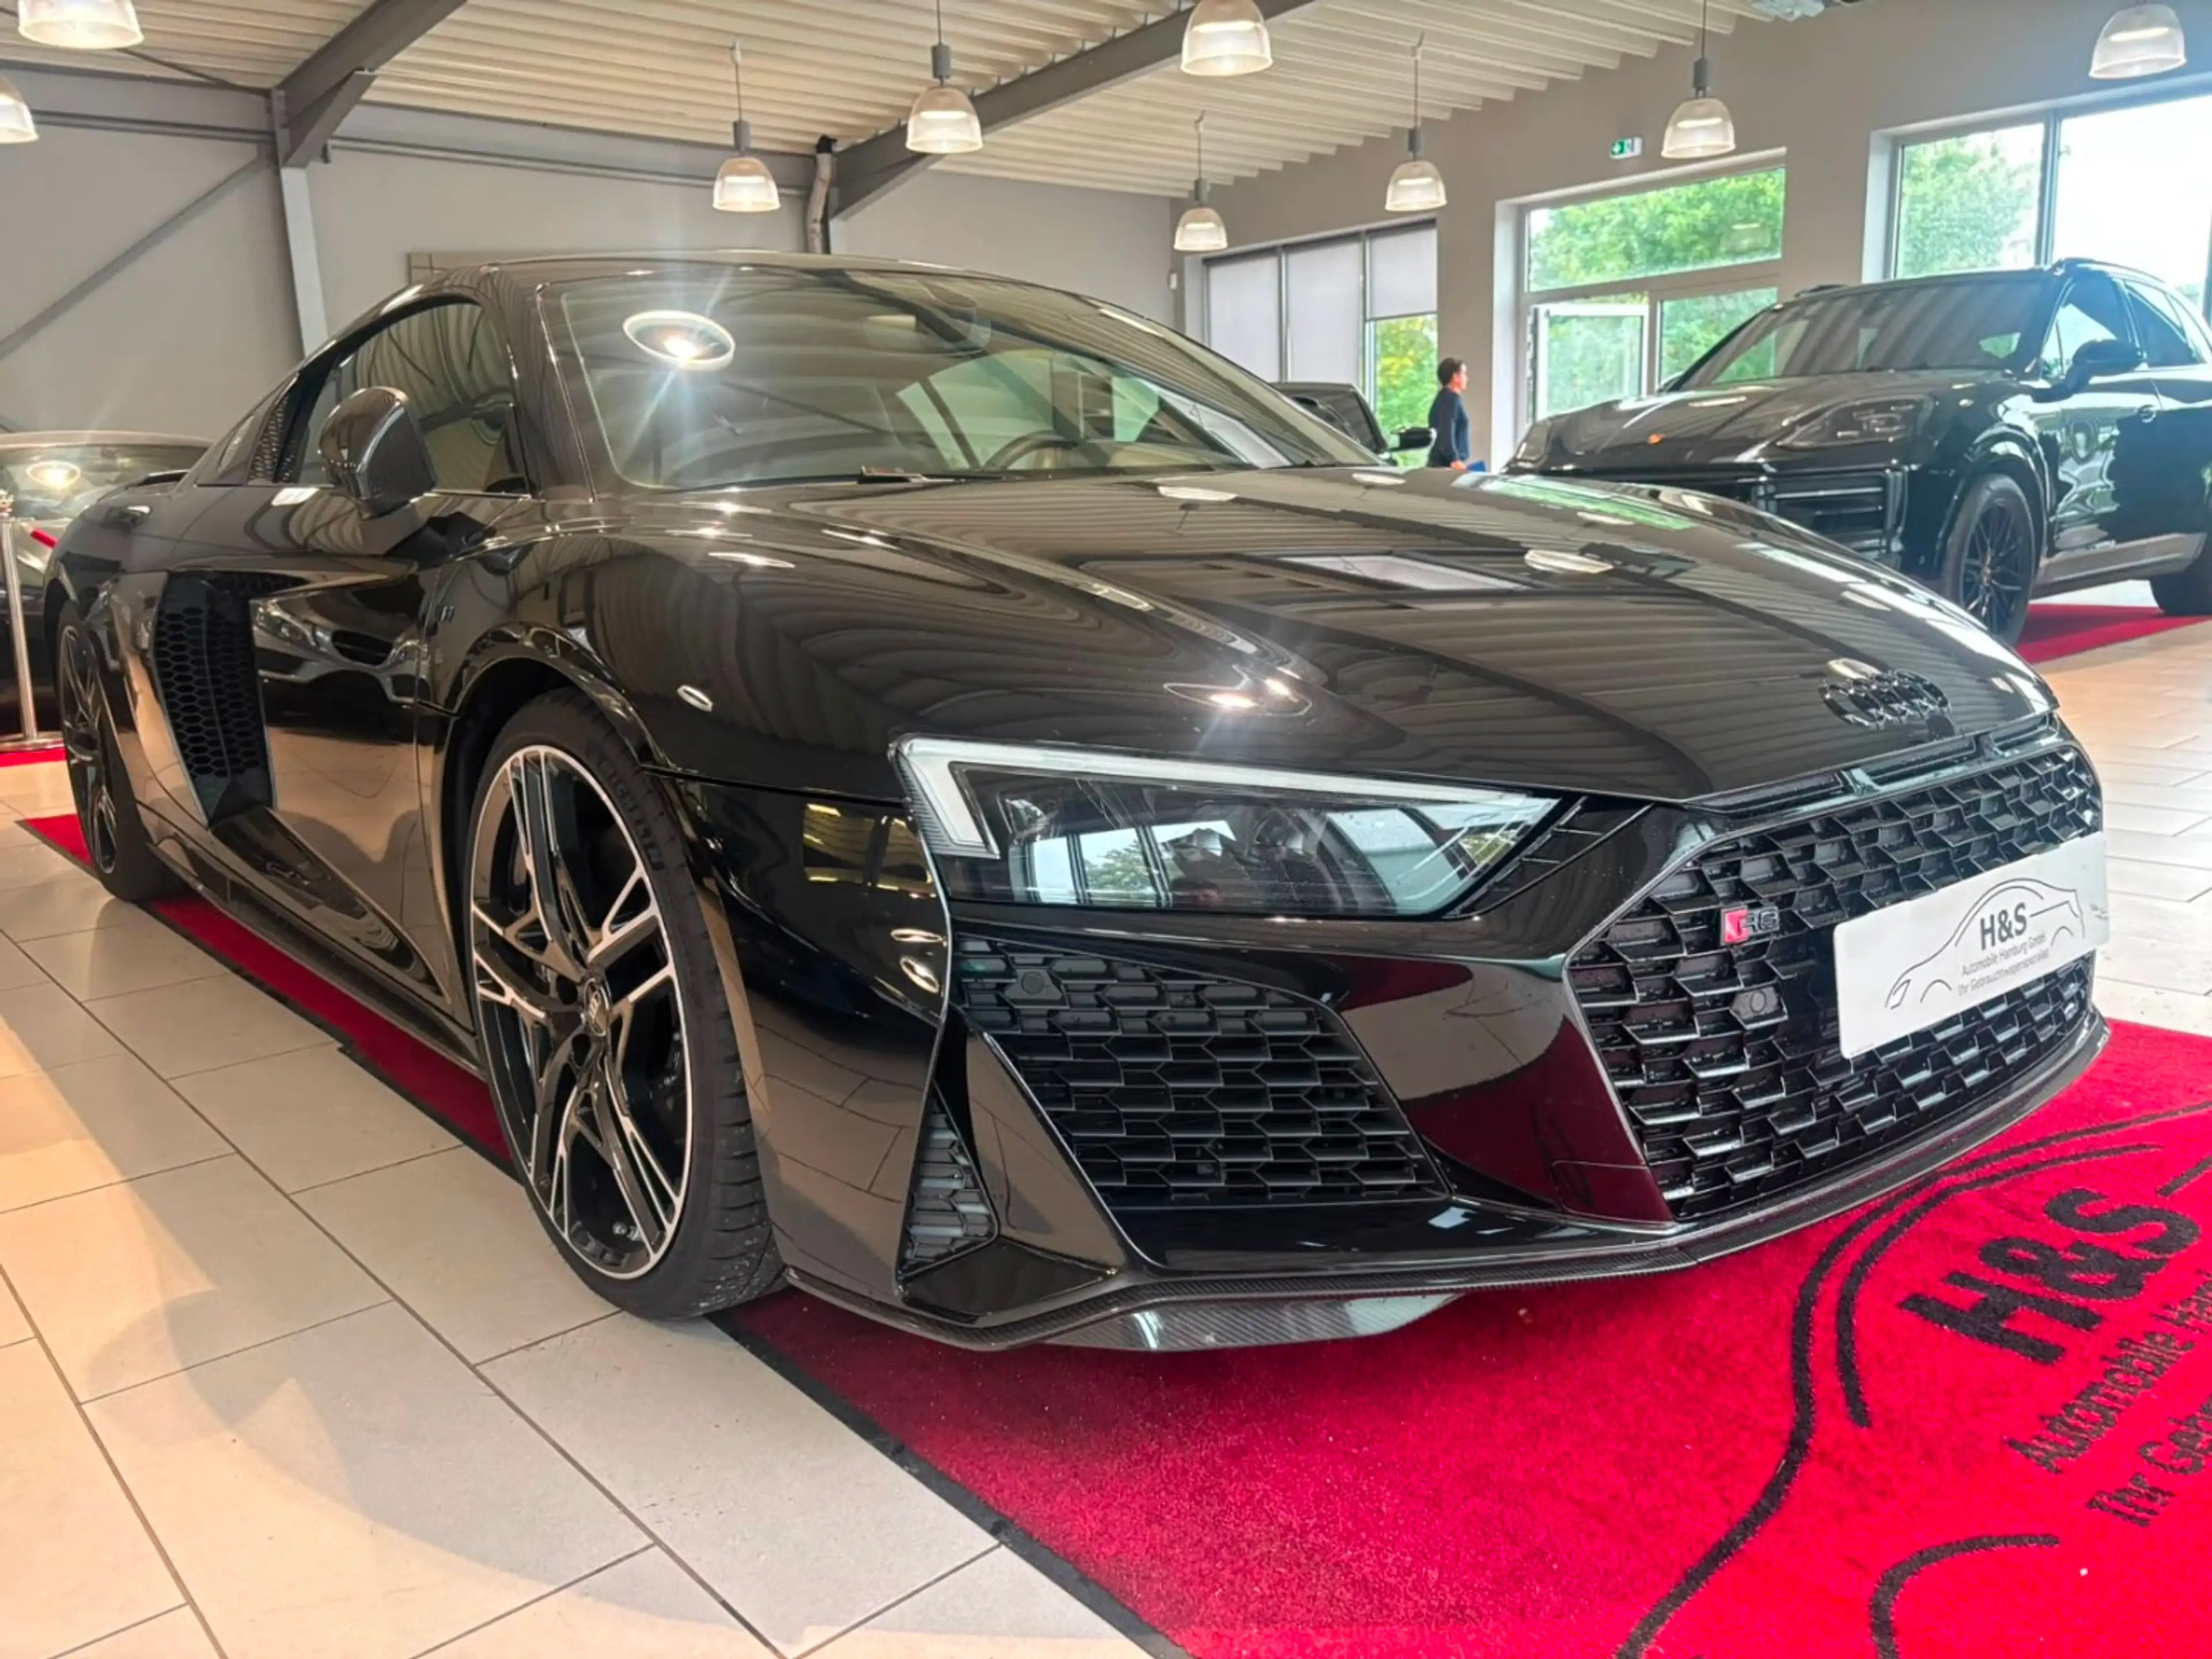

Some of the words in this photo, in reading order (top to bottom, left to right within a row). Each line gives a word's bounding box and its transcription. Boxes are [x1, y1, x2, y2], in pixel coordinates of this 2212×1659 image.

[1980, 902, 2027, 951] H&S
[1899, 1188, 2200, 1365] H&S
[2007, 1332, 2195, 1475] Automobile
[2085, 1472, 2176, 1528] Ihr
